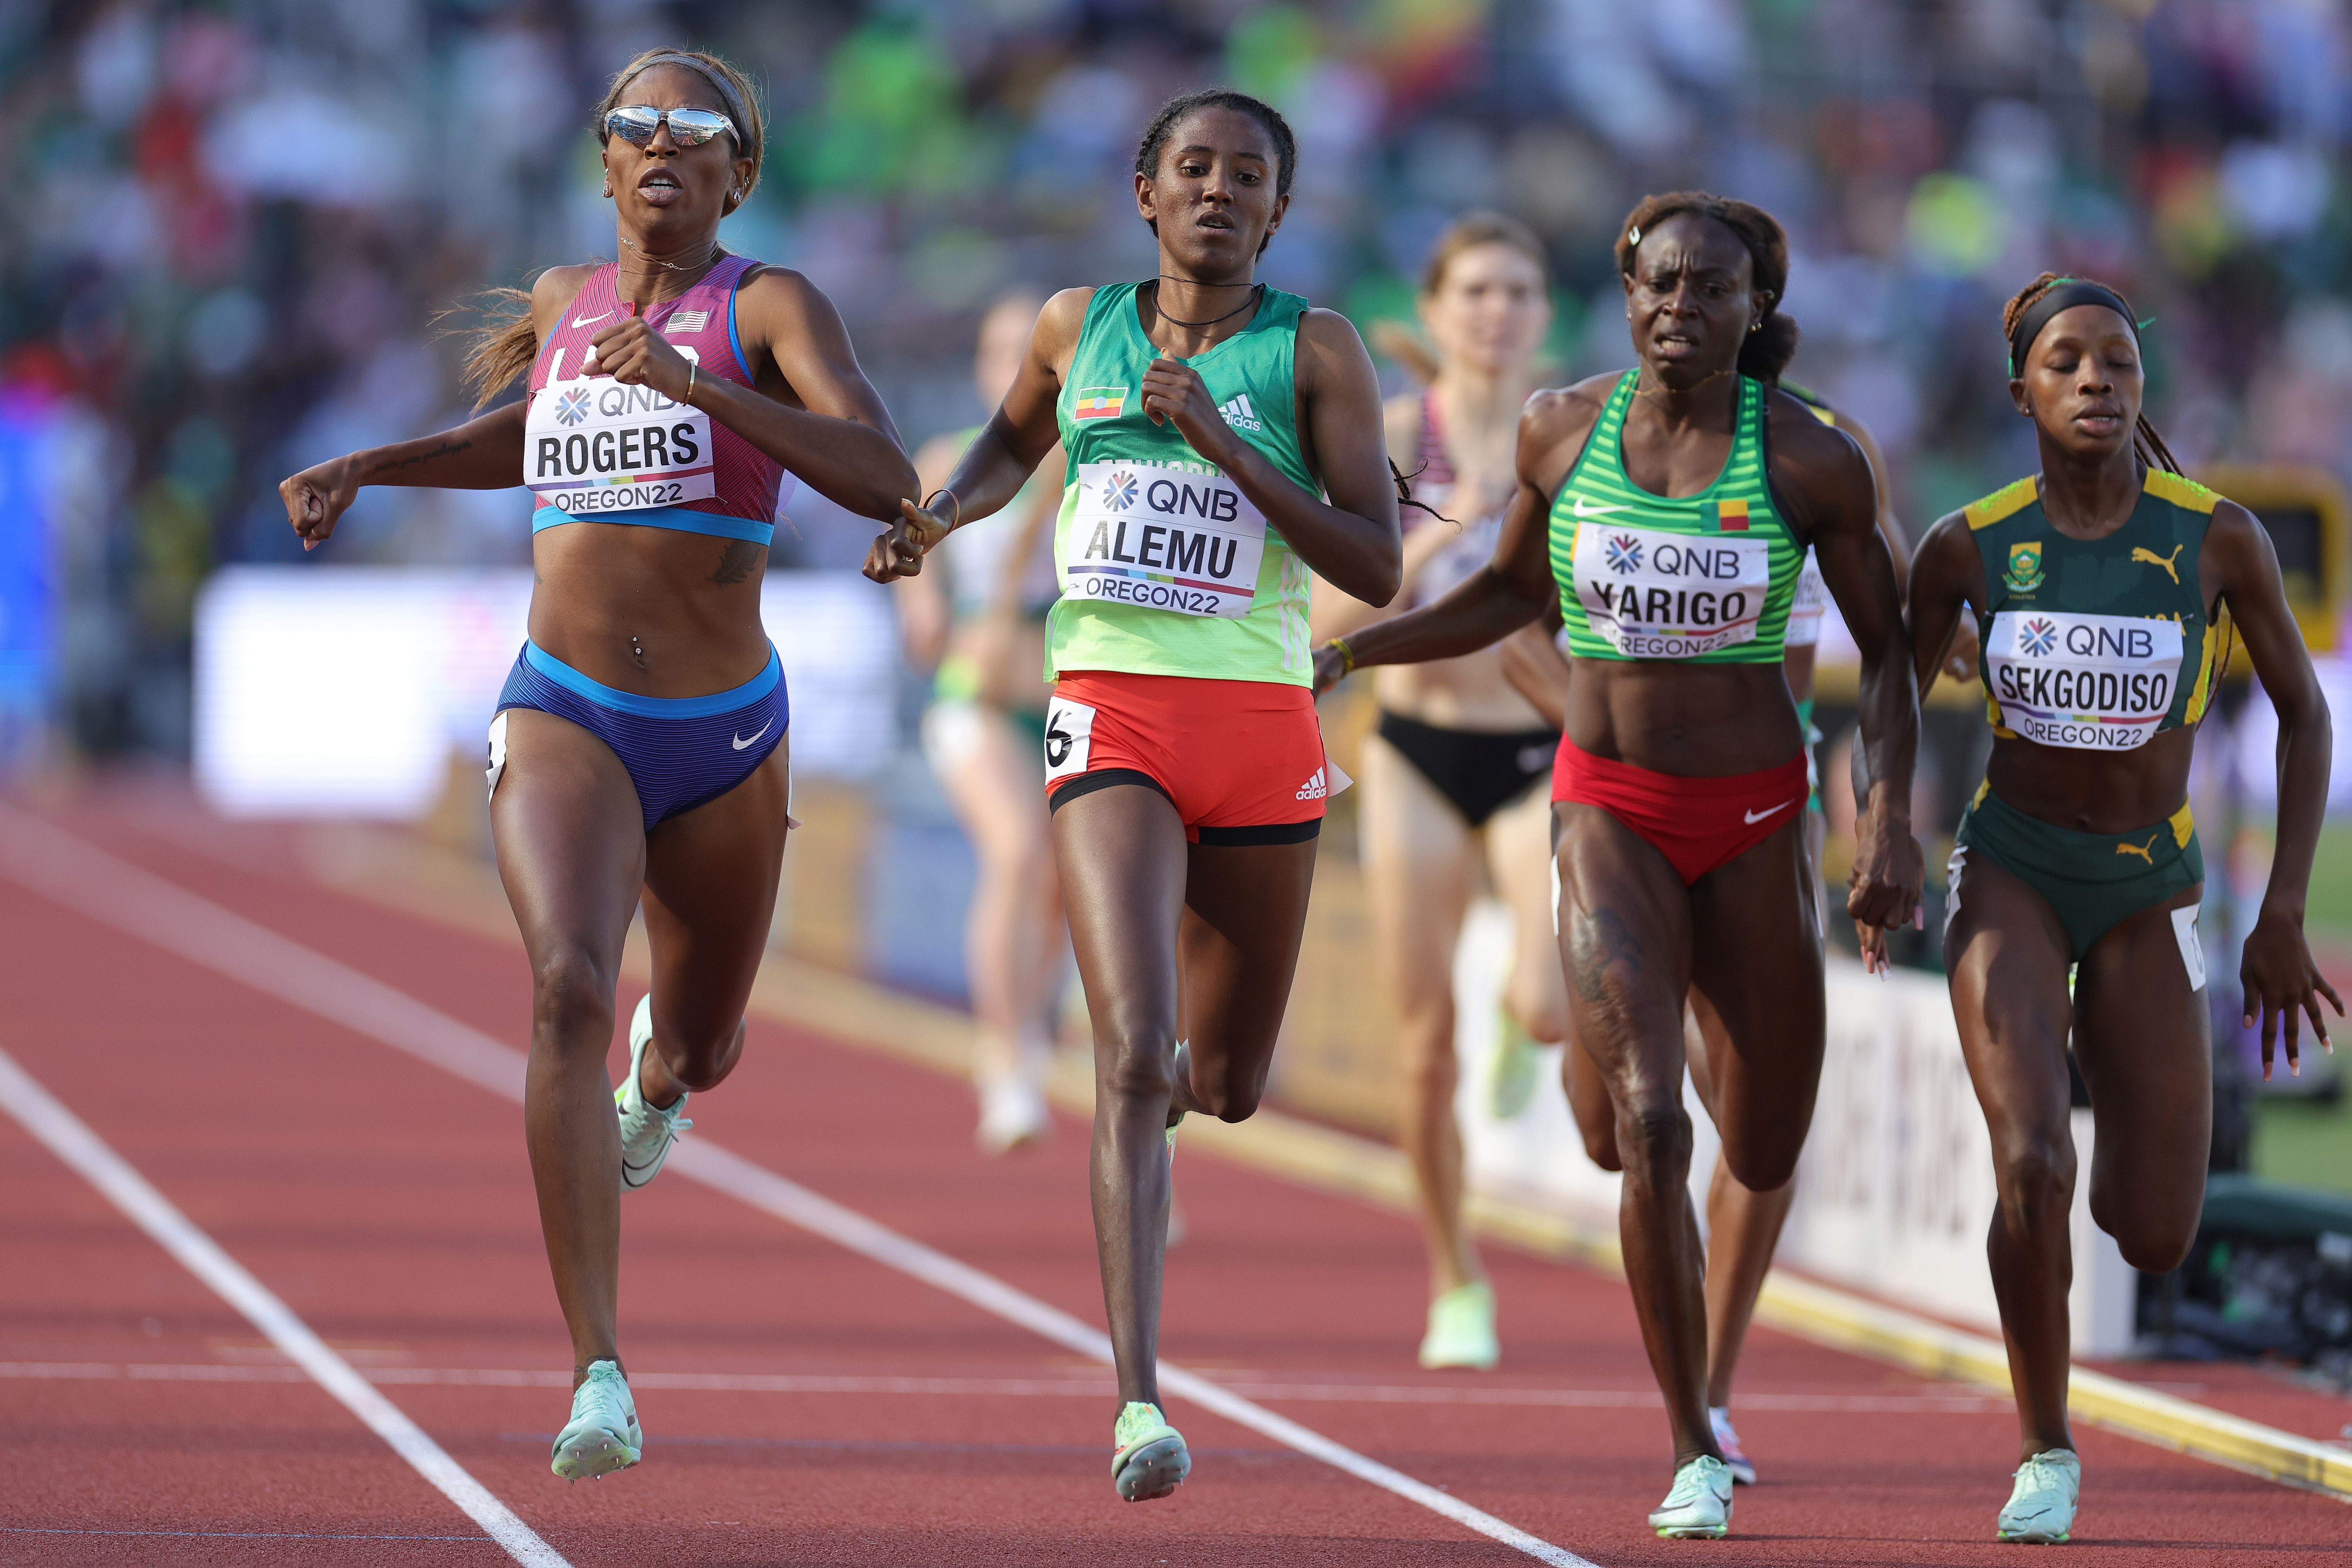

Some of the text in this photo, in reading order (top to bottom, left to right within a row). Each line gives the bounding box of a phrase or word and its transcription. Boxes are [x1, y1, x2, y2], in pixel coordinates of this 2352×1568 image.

[1222, 412, 1261, 431] didas
[537, 424, 699, 477] ROGERS
[555, 483, 683, 512] OREGON22
[1147, 480, 1238, 522] QNB
[1084, 520, 1237, 579] ALEMU
[1654, 545, 1739, 579] QNB
[1086, 577, 1220, 614] OREGON22
[1591, 580, 1746, 625] YARIGO
[1620, 632, 1729, 654] REGON22
[2066, 625, 2153, 658] QNB
[1999, 664, 2167, 713] SEKGODISO
[1046, 708, 1073, 768] 6
[2024, 718, 2143, 747] OREGON22
[1296, 786, 1326, 800] adidas
